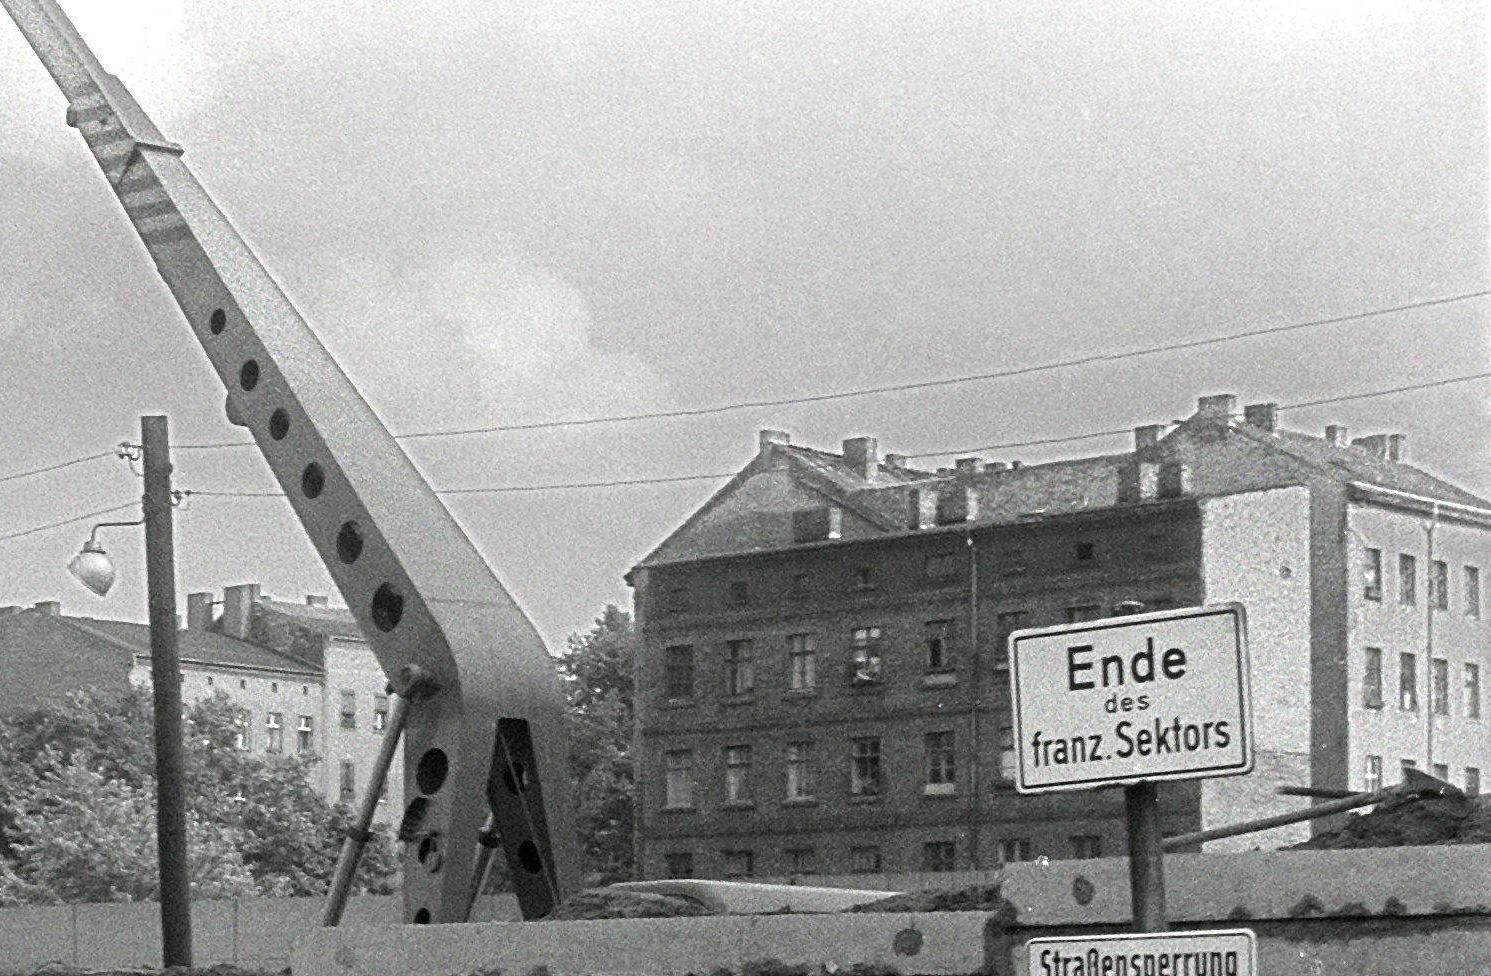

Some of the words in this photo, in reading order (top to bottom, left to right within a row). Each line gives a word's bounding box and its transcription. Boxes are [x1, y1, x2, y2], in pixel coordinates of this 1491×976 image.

[1067, 636, 1187, 691] Ende
[1104, 692, 1151, 714] des
[1031, 730, 1112, 768] franz.
[1115, 716, 1231, 759] Sektors
